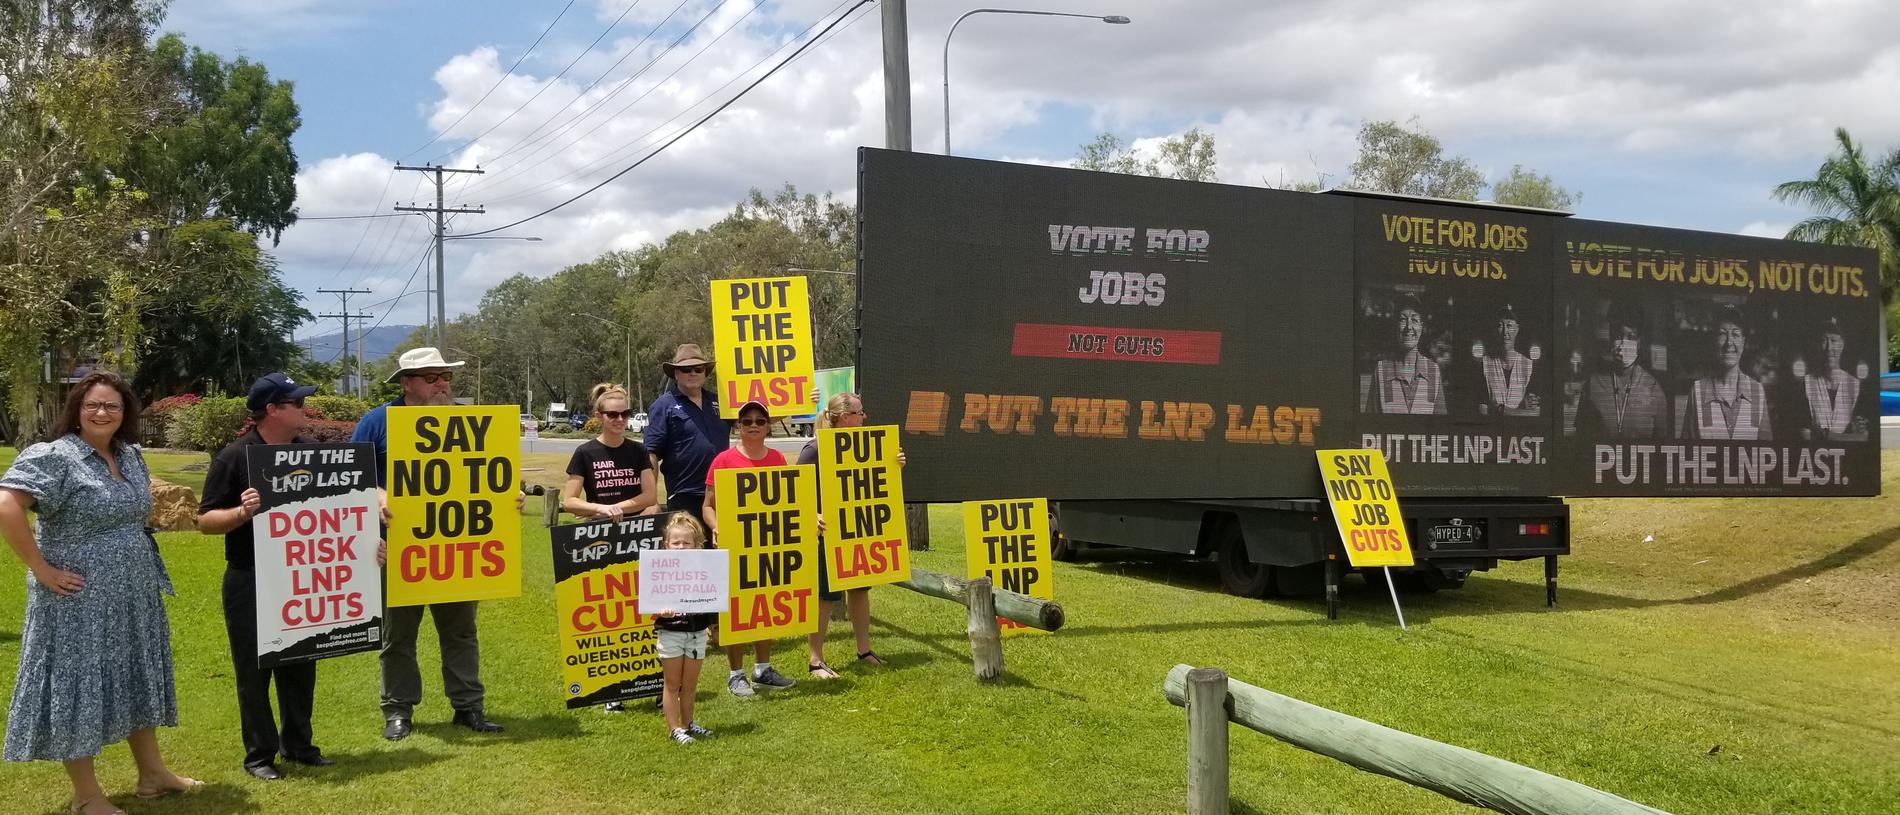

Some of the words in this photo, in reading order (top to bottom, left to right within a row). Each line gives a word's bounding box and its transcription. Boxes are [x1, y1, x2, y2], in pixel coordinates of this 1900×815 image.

[1048, 224, 1135, 256] VOTE
[1145, 228, 1210, 260] FOR
[1382, 214, 1433, 244] VOTE
[1438, 219, 1476, 248] FOR
[1480, 223, 1528, 252] JOBS
[1408, 250, 1448, 275] NOT
[1452, 253, 1507, 280] CUTS.
[1566, 241, 1632, 277] VOTE
[1637, 247, 1684, 282] FOR
[1689, 254, 1754, 293] JOBS,
[1759, 260, 1804, 292] NOT
[1808, 264, 1869, 298] CUTS.
[730, 280, 791, 310] PUT
[1078, 270, 1166, 306] JOBS
[732, 312, 794, 342] THE
[734, 344, 796, 375] LNP
[1067, 333, 1107, 353] NOT
[1113, 335, 1165, 356] CUTS
[728, 376, 808, 408] LAST
[960, 392, 1043, 436] PUT
[1049, 395, 1130, 439] THE
[1138, 400, 1216, 441] LNP
[1225, 403, 1321, 445] LAST
[415, 415, 492, 454] SAY
[834, 430, 886, 464] PUT
[1362, 434, 1404, 463] PUT
[1408, 434, 1448, 463] THE
[1453, 435, 1493, 463] LNP
[1497, 435, 1546, 464] LAST.
[275, 450, 314, 466] PUT
[320, 449, 355, 464] THE
[593, 460, 615, 469] HAIR
[1333, 455, 1373, 477] SAY
[1595, 444, 1655, 485] PUT
[1661, 445, 1716, 485] THE
[1723, 446, 1777, 485] LNP
[1783, 447, 1848, 485] LAST.
[272, 474, 310, 492] LNP
[317, 471, 362, 487] LAST
[393, 458, 451, 497] NO
[463, 456, 513, 495] TO
[594, 468, 635, 479] STYLISTS
[596, 477, 641, 488] AUSTRALIA
[736, 469, 800, 507] PUT
[836, 466, 888, 502] THE
[1329, 479, 1362, 501] NO
[1364, 478, 1391, 501] TO
[269, 506, 368, 538] DON'T
[412, 499, 493, 539] JOB
[574, 523, 612, 540] PUT
[618, 518, 654, 534] THE
[737, 509, 802, 549] THE
[839, 504, 891, 540] LNP
[980, 502, 1034, 532] PUT
[1351, 503, 1390, 526] JOB
[285, 535, 357, 567] RISK
[572, 545, 608, 562] LNP
[616, 536, 663, 555] LAST
[982, 534, 1037, 565] THE
[1350, 528, 1403, 551] CUTS
[400, 540, 506, 583] CUTS
[651, 558, 680, 568] HAIR
[739, 550, 803, 590] LNP
[834, 539, 902, 579] LAST
[292, 564, 352, 596] LNP
[651, 571, 708, 581] STYLISTS
[651, 583, 717, 594] AUSTRALIA
[281, 592, 364, 626] CUTS
[571, 598, 657, 632] CUT
[730, 588, 812, 632] LAST
[576, 635, 615, 649] WILL
[620, 628, 659, 643] CRAS
[566, 643, 658, 666] QUEENSLAN
